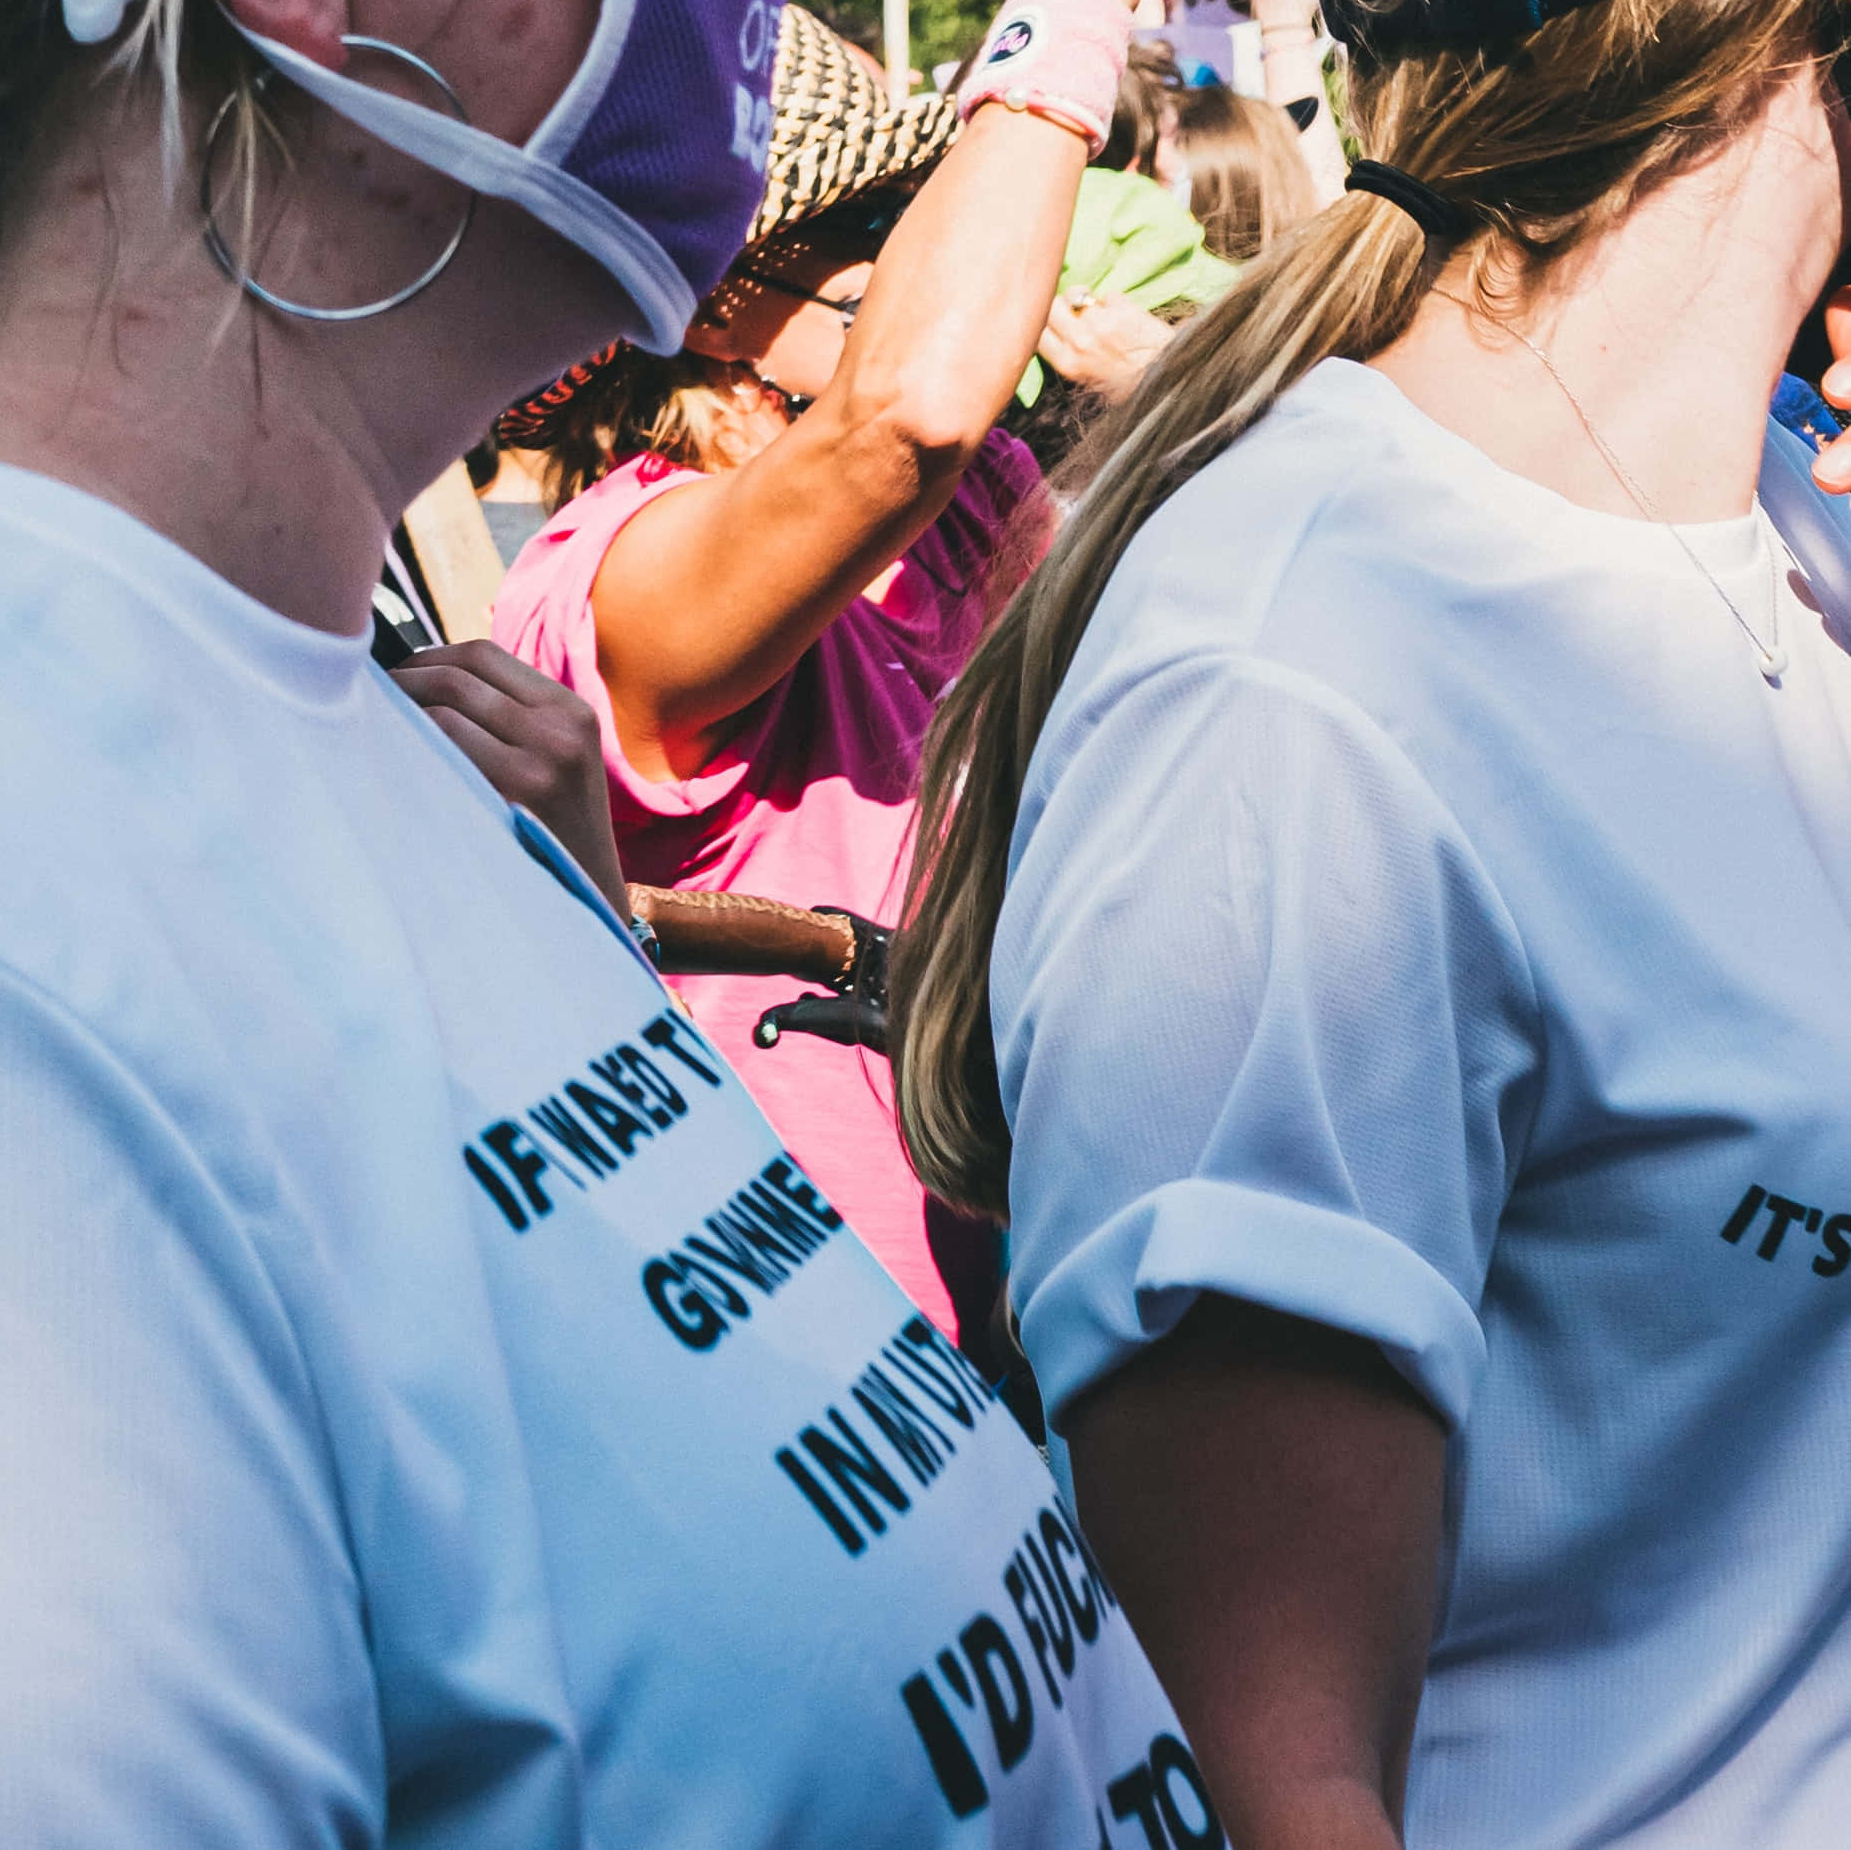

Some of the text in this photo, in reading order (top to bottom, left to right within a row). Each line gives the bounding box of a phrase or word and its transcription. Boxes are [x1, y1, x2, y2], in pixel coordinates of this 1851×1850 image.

[463, 1116, 554, 1235] IF
[1721, 1183, 1851, 1278] IT'S
[775, 1406, 912, 1558] IN
[901, 1611, 1034, 1820] I'D
